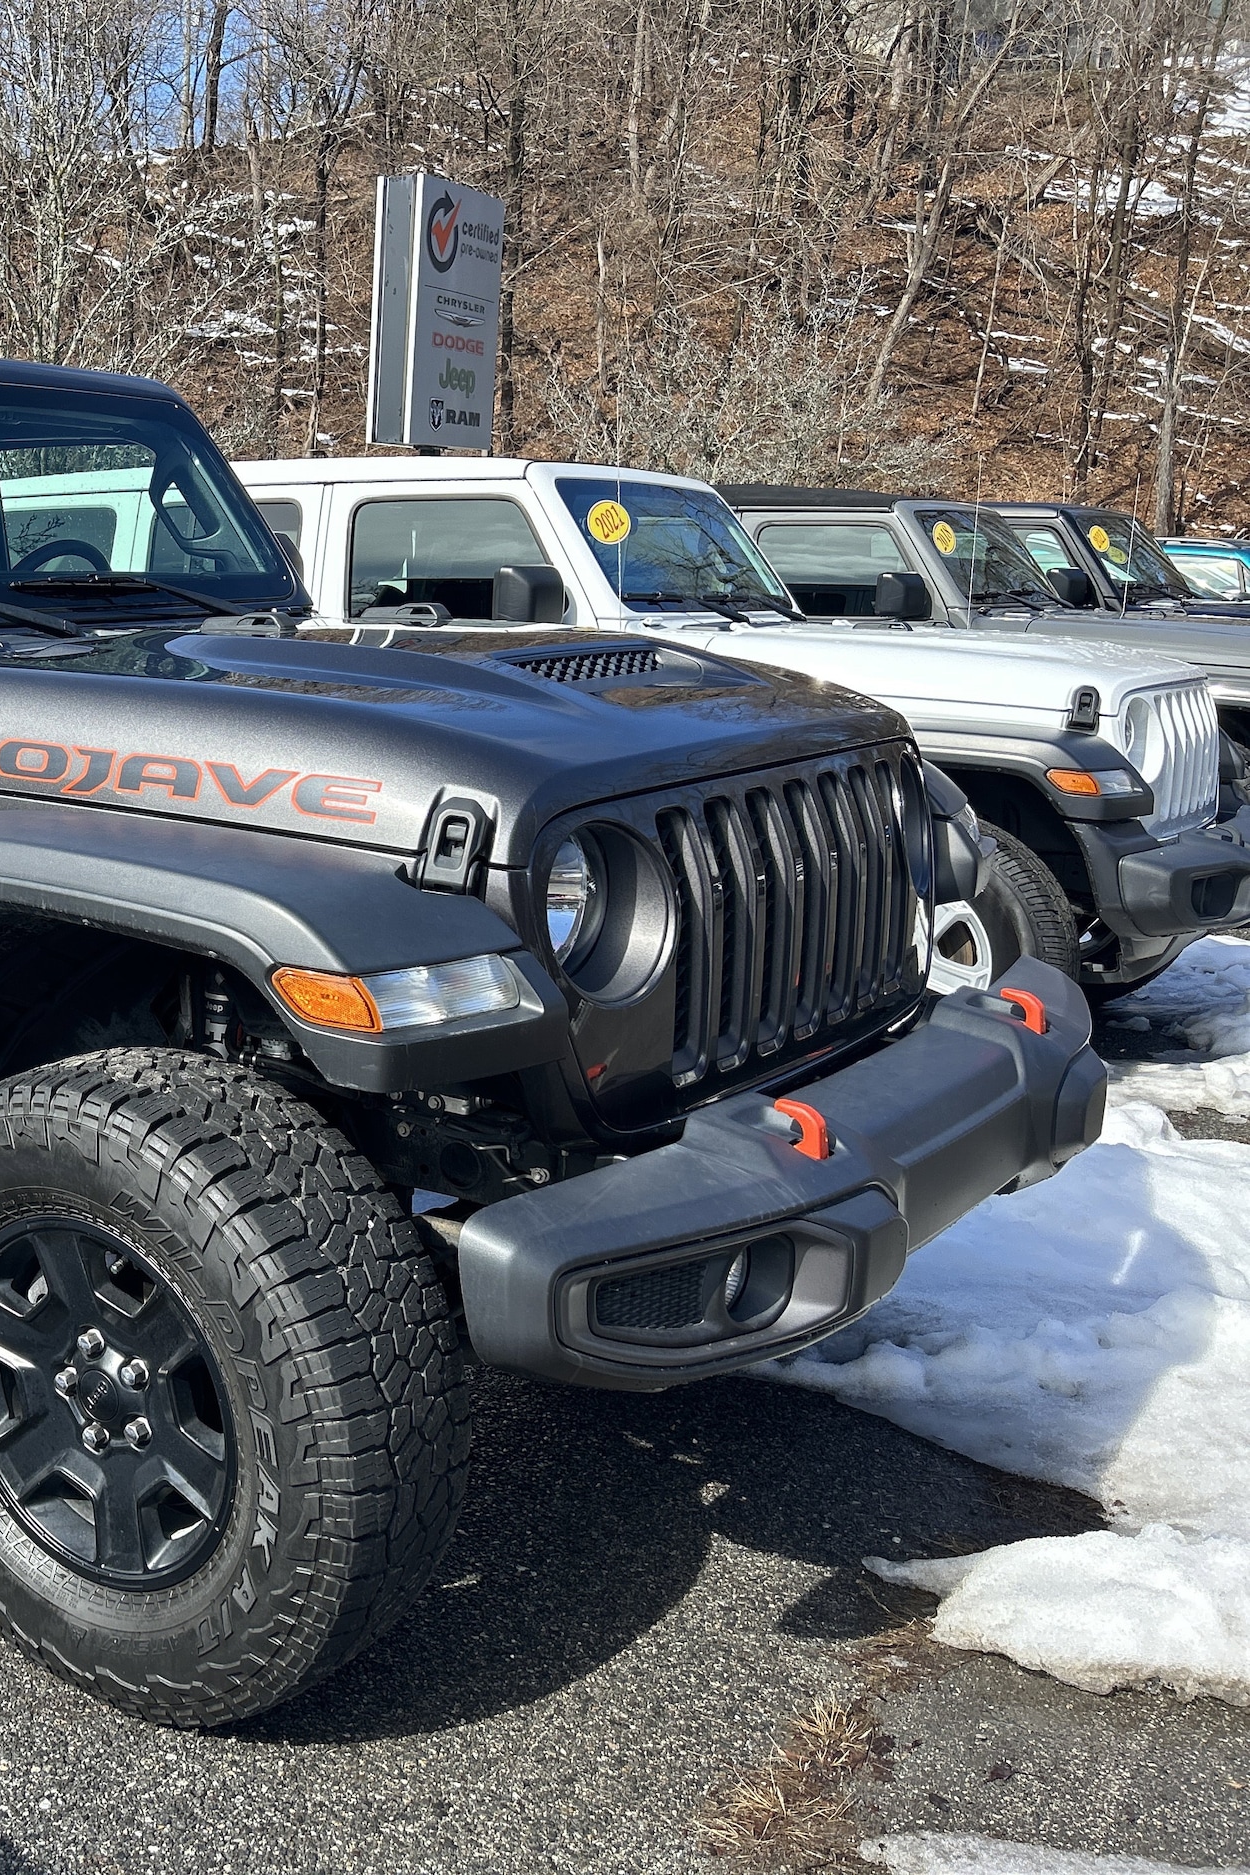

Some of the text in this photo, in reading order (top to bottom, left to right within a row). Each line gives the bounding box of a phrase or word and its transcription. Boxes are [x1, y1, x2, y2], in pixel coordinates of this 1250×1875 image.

[461, 221, 500, 246] certified
[460, 242, 499, 264] pre-owned
[436, 295, 485, 314] CHRYSLER
[432, 332, 485, 356] DODGE
[439, 358, 475, 399] Jeep
[445, 409, 481, 428] RAM
[594, 504, 625, 539] 2021
[108, 1188, 281, 1573] WILDPEAK
